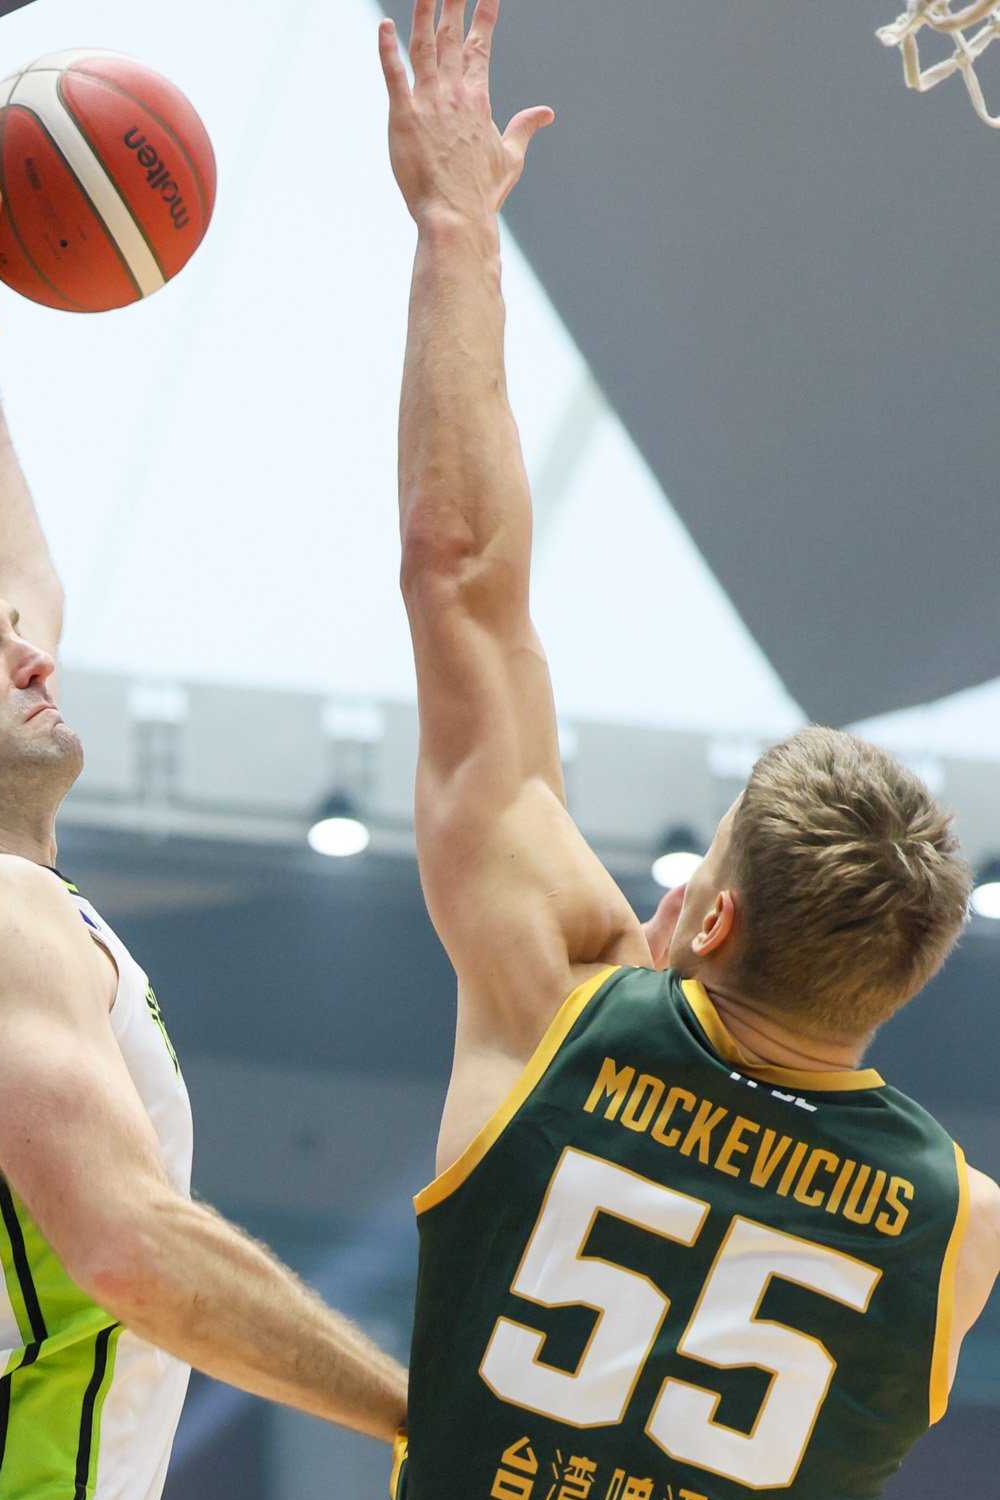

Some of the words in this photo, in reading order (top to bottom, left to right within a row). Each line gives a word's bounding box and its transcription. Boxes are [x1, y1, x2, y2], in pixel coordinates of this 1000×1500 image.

[123, 125, 190, 230] molten
[583, 1057, 914, 1236] MOCKEVICIUS
[478, 1145, 883, 1490] 55
